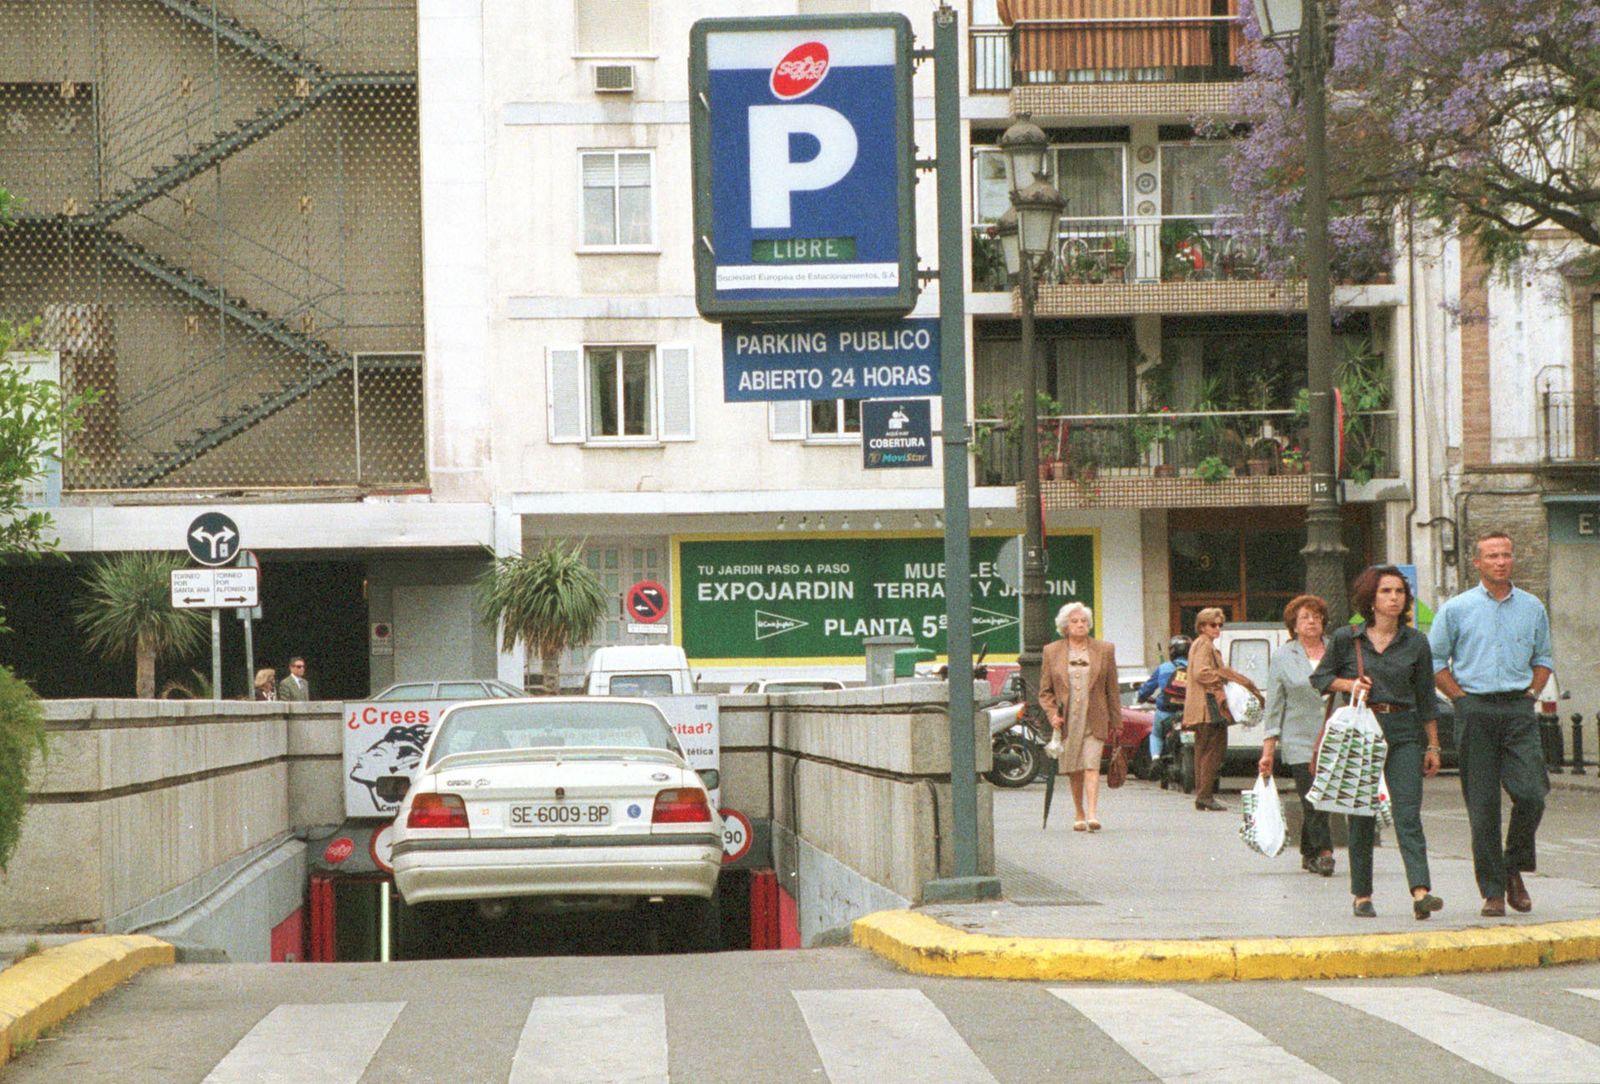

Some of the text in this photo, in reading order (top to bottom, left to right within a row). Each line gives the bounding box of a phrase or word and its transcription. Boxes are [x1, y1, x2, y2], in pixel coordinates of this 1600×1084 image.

[748, 103, 859, 229] P
[773, 238, 839, 259] LIBRE
[717, 273, 757, 282] Sociedad
[758, 273, 795, 283] Europea
[795, 272, 806, 281] de
[736, 329, 931, 355] PARKING PUBLICO
[738, 365, 932, 391] ABIERTO 24 HORAS
[869, 437, 926, 449] COBERTURA
[698, 563, 850, 576] TU JARDIN PASO A PASO
[698, 581, 854, 601] EXPOJARDIN
[979, 581, 992, 597] Y
[1000, 579, 1076, 597] JDIN
[824, 617, 914, 637] PLANTA
[347, 706, 431, 731] ¿Crees
[672, 722, 713, 735] itad?
[686, 747, 714, 757] tética
[511, 805, 609, 824] SE-6009-BP
